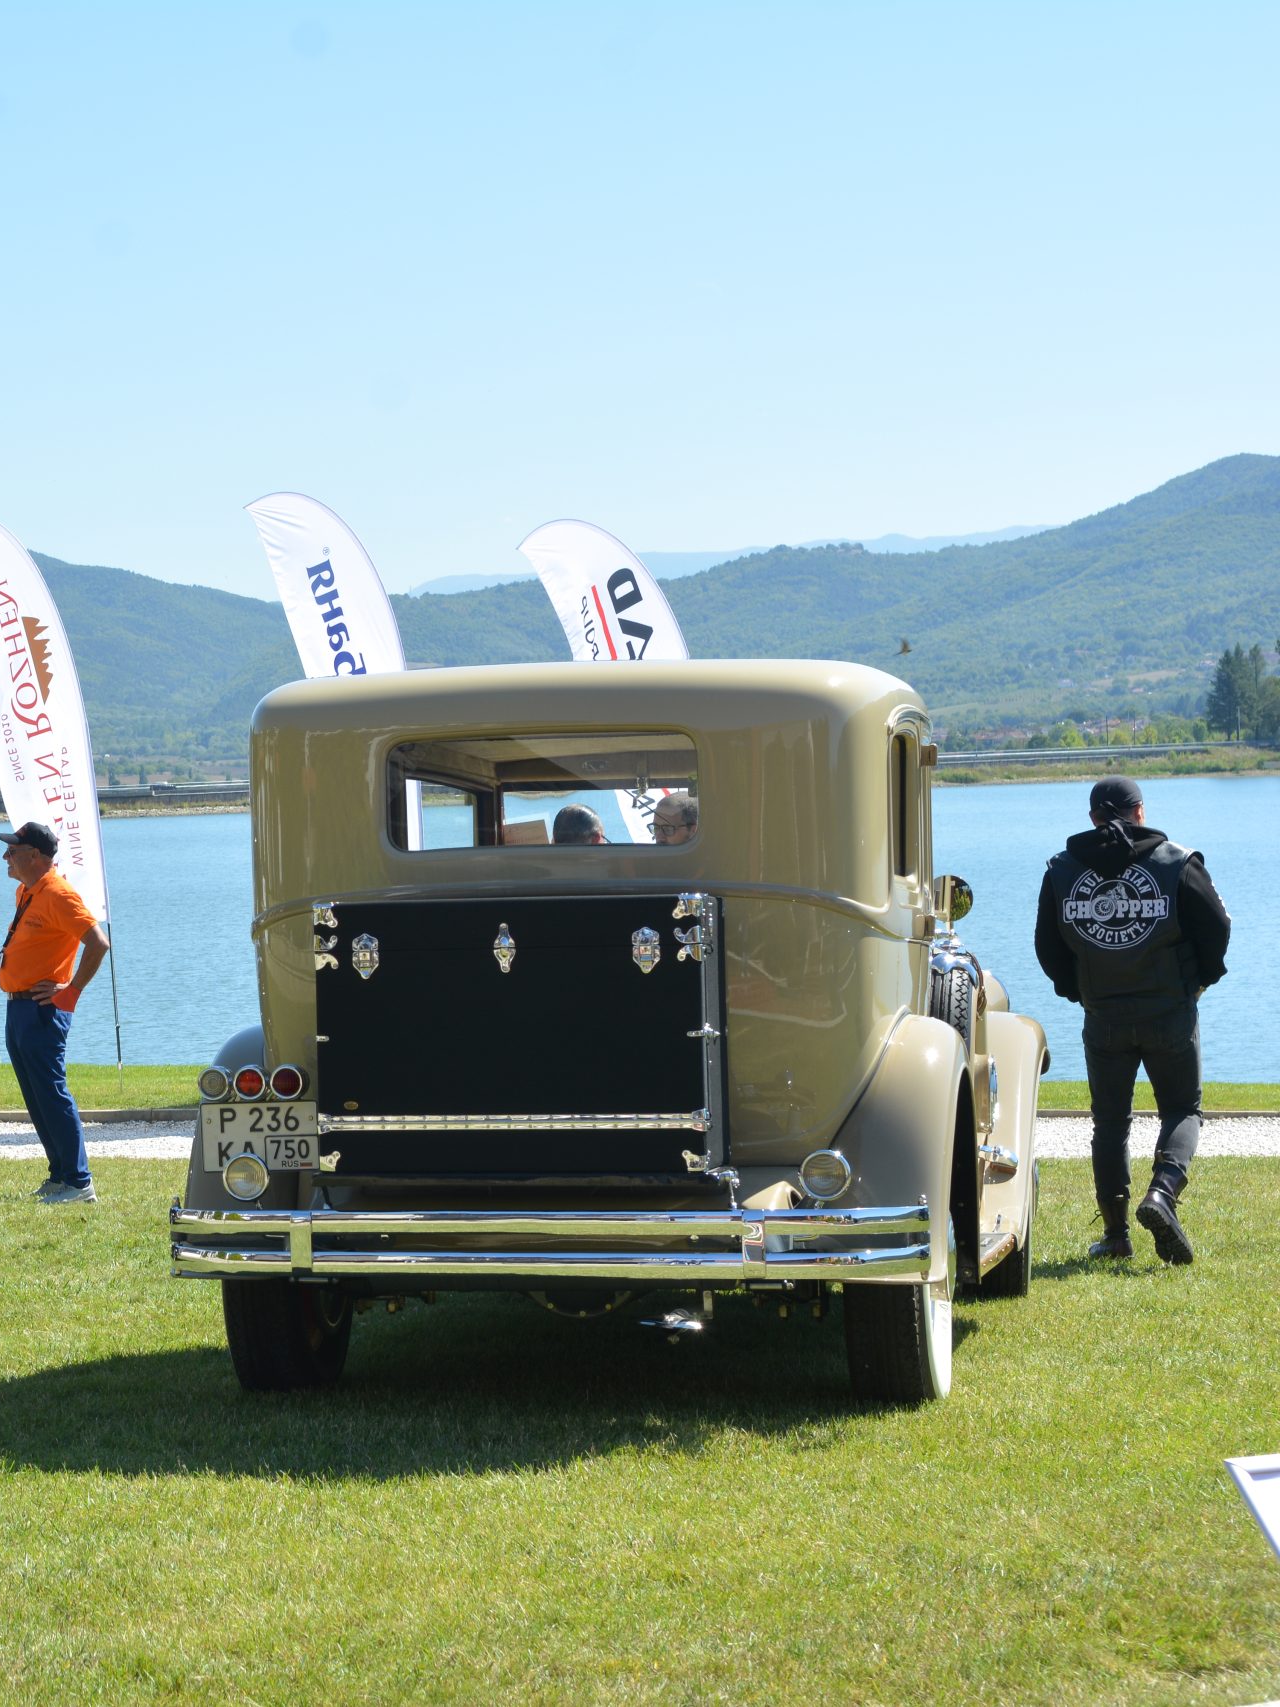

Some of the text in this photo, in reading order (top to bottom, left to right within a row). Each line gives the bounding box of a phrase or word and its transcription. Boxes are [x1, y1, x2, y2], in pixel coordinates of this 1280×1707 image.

[1078, 868, 1153, 896] BULRIAN
[1065, 897, 1166, 921] CHOPPER
[1087, 921, 1144, 943] SOCIETY
[220, 1106, 300, 1133] P 236
[270, 1139, 310, 1159] 750
[281, 1160, 299, 1168] RUS
